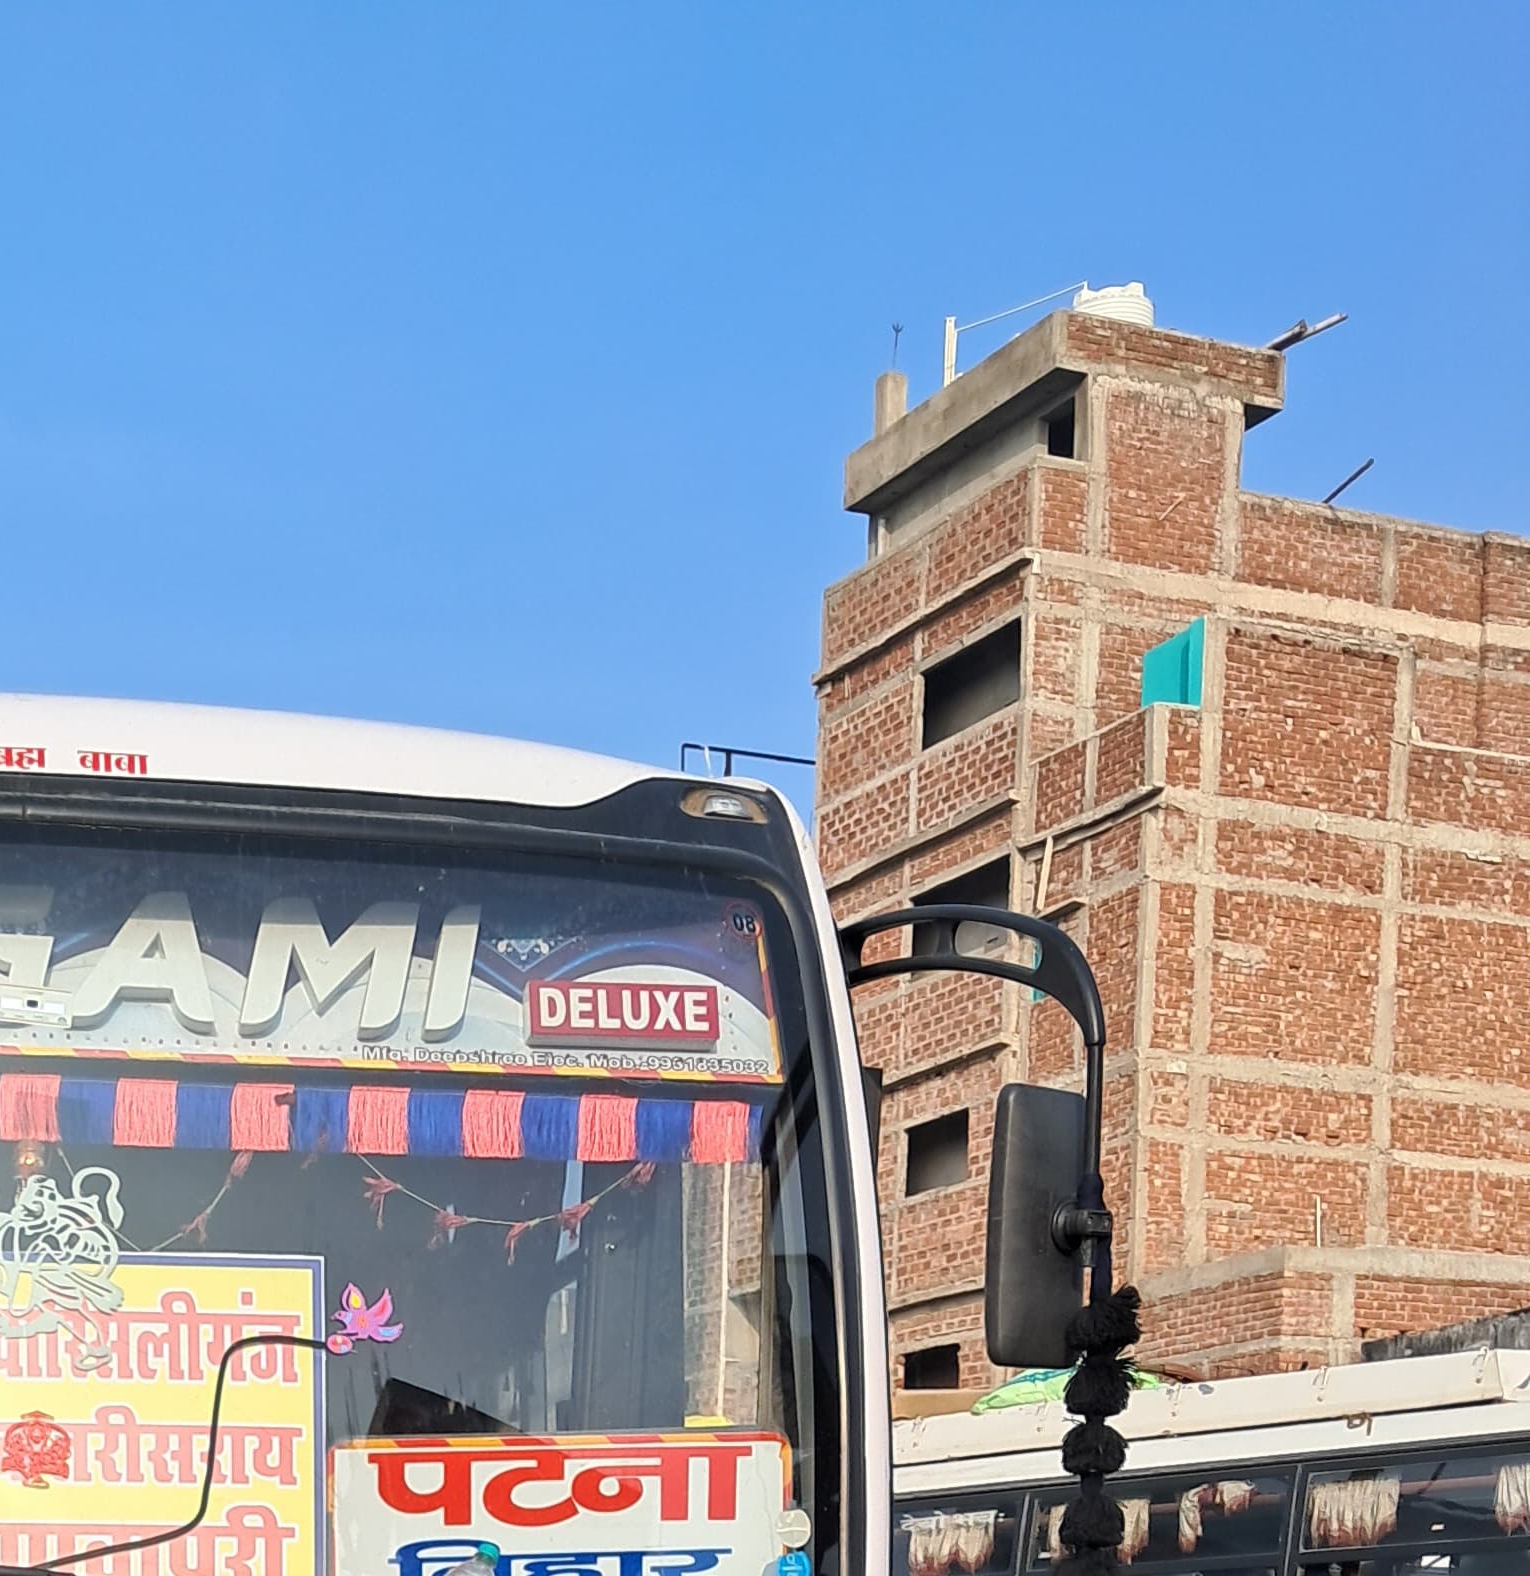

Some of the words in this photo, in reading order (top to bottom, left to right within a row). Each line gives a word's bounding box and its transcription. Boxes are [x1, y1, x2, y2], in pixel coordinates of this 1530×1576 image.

[77, 750, 149, 775] बाबा
[733, 913, 756, 933] 08
[539, 986, 711, 1032] DELUXE
[368, 1446, 752, 1527] पटना
